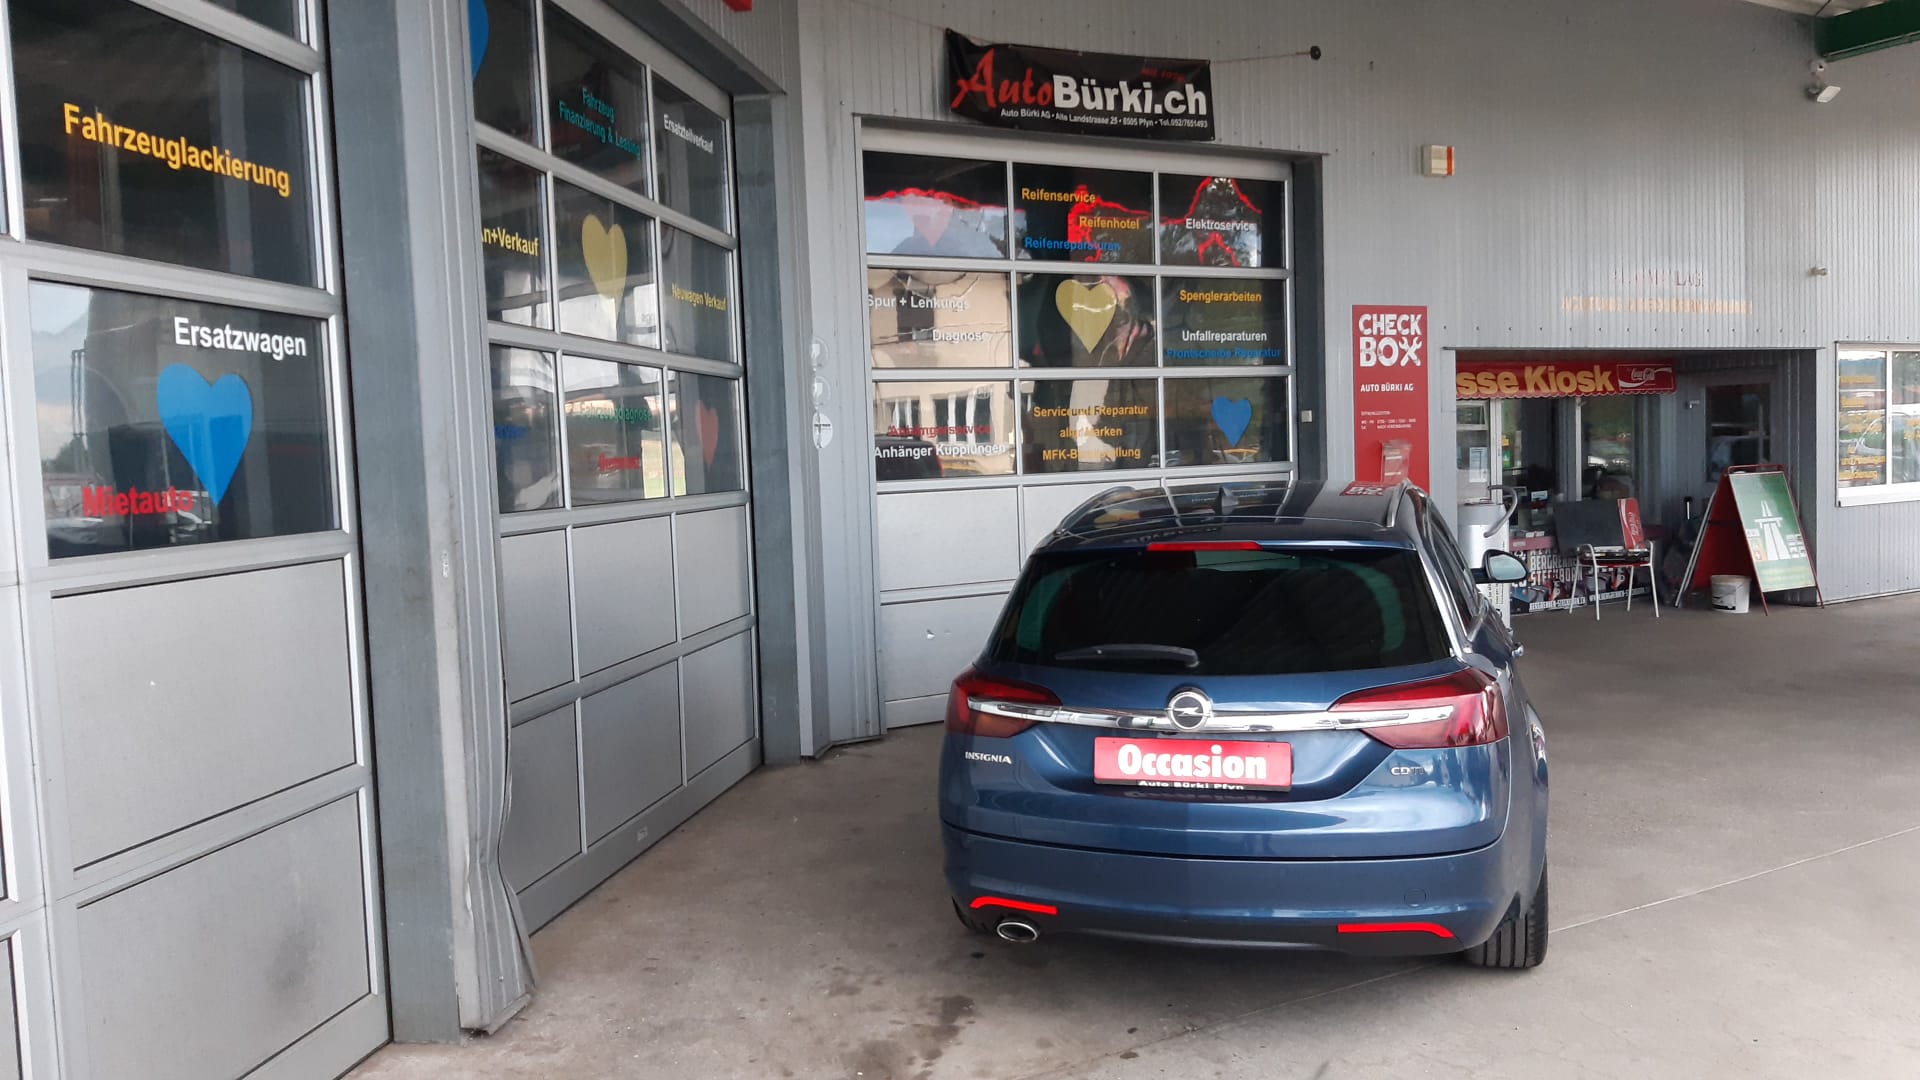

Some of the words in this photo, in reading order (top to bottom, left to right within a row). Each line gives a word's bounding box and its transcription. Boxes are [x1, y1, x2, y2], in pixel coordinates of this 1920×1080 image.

[582, 87, 615, 123] Fahrzeug
[1001, 108, 1019, 118] Auto
[1020, 108, 1040, 118] Bürki
[1055, 112, 1068, 122] Alte
[1069, 114, 1109, 125] Landstrasse
[559, 101, 605, 143] Finanzierung
[607, 127, 613, 143] &
[615, 131, 641, 160] Leasing
[663, 113, 714, 154] Ersatzteilverkauf
[63, 103, 290, 197] Fahrzeuglackierung
[1021, 187, 1096, 203] Reifenservice
[1079, 215, 1140, 230] Reifenhotel
[1185, 218, 1256, 232] Elektroservice
[481, 226, 538, 256] n+Verkauf
[1024, 237, 1121, 251] Reifenreparaturen
[671, 282, 704, 307] Neuwagen
[704, 291, 726, 311] Verkauf
[867, 294, 896, 309] Spur
[900, 297, 907, 306] +
[911, 296, 970, 311] Lenkungs
[1179, 289, 1262, 304] Spenglerarbeiten
[1358, 313, 1422, 336] CHECK
[174, 316, 307, 361] Ersatzwagen
[1181, 330, 1267, 343] Unfallreparaturen
[1359, 336, 1423, 367] BOX
[1360, 383, 1380, 393] AUTO
[1381, 382, 1402, 392] BÜRKI
[1404, 383, 1414, 391] AG
[1456, 369, 1520, 394] sse
[1524, 364, 1616, 393] Kiosk
[583, 405, 652, 424] ahrzeugdiagnose
[1099, 405, 1149, 417] Reparatur
[1085, 426, 1123, 437] arken
[874, 445, 932, 460] Anhänger
[936, 443, 1006, 457] Kupplungen
[82, 485, 194, 517] Mietauto
[965, 751, 1012, 764] INSIGNIA
[1117, 743, 1268, 780] Occasion
[1137, 780, 1170, 788] Auto
[1173, 781, 1209, 789] Bürki
